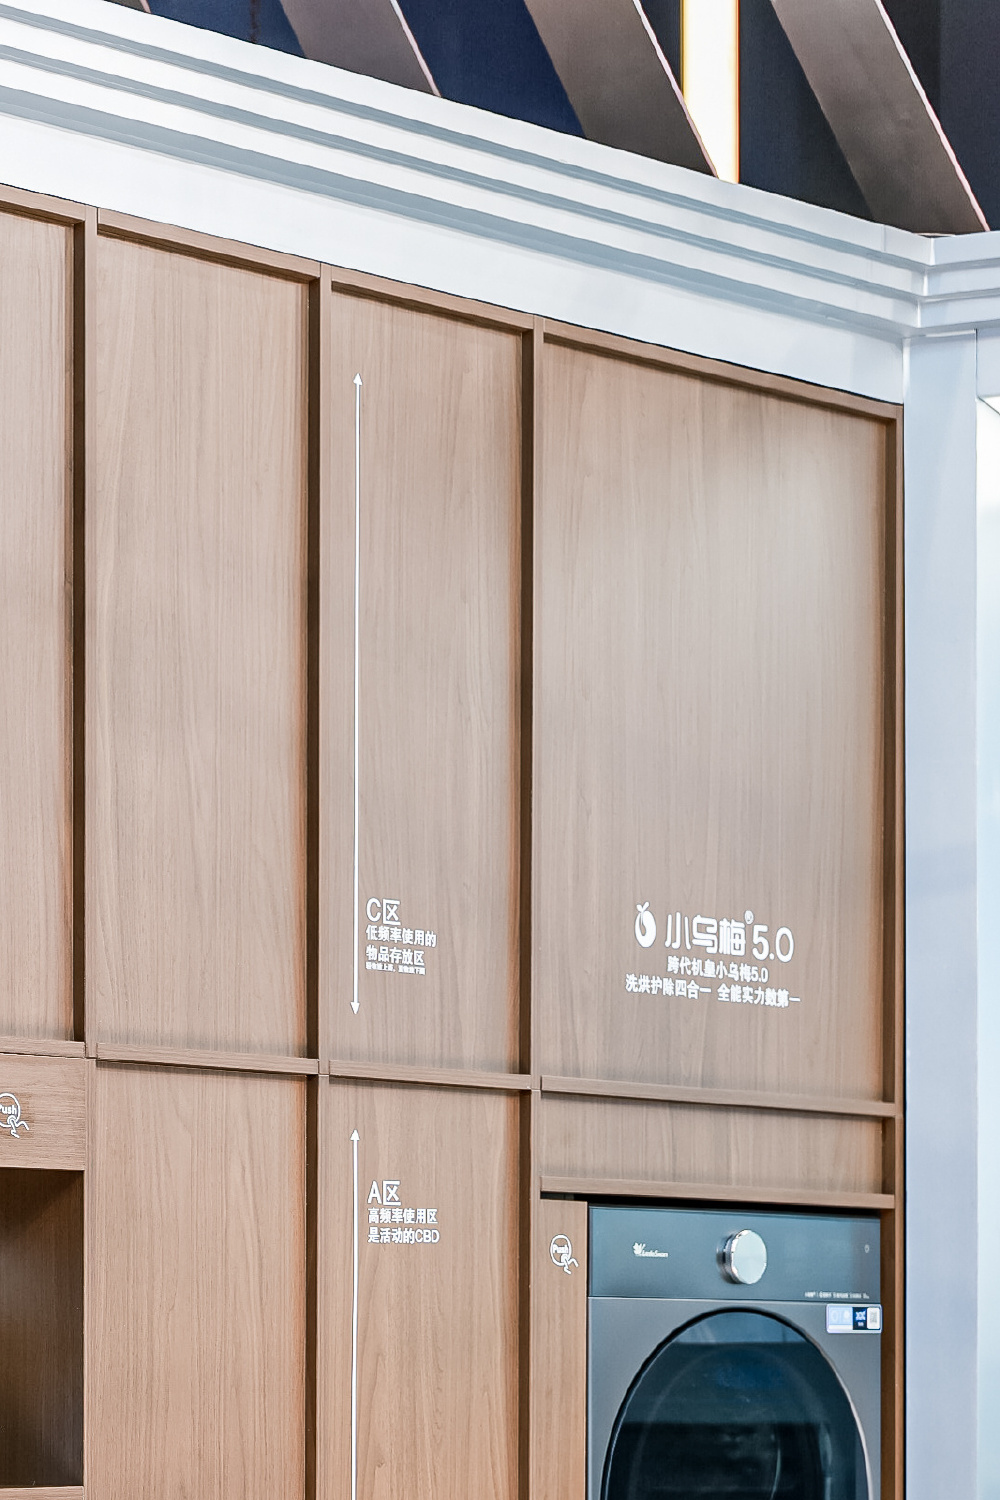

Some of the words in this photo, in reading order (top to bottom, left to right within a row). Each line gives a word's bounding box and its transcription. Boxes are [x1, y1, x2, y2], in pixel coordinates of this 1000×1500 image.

[366, 897, 401, 925] C区
[366, 924, 437, 948] 低频率使用的
[752, 924, 794, 963] 5.0
[366, 944, 425, 966] 物品存放区
[625, 973, 712, 999] 洗烘护除四合一
[367, 1180, 402, 1206] A区
[367, 1207, 438, 1224] 高频率使用区
[367, 1226, 440, 1244] 是活动的CBD
